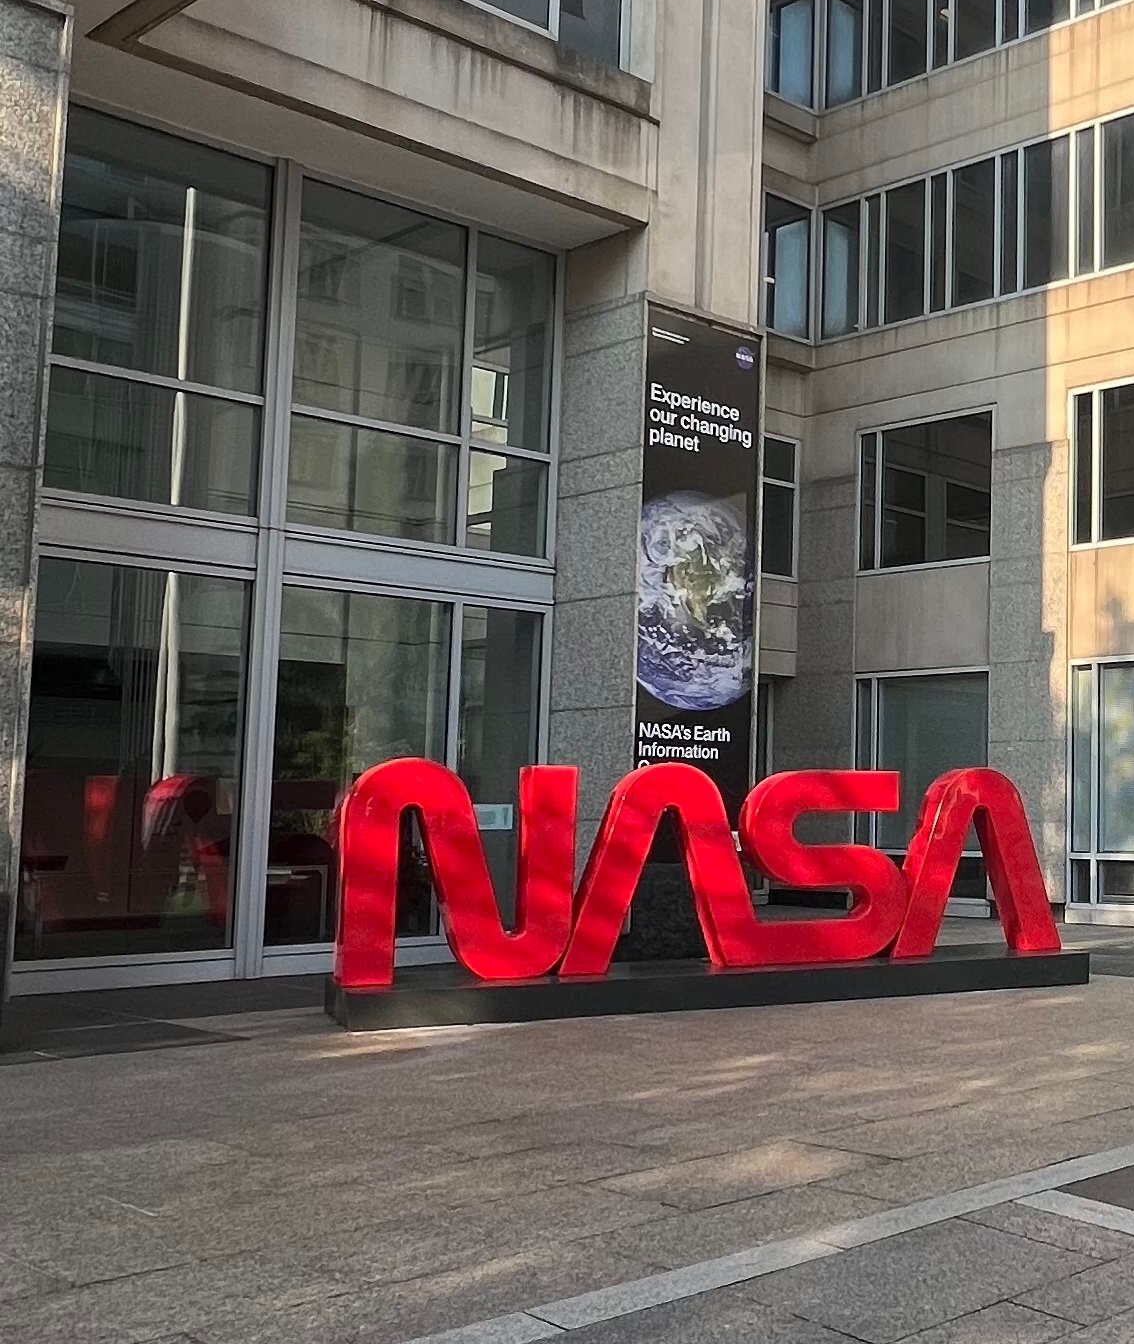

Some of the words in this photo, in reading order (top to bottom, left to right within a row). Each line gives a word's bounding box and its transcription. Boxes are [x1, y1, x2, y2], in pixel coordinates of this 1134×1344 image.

[650, 382, 740, 421] Experience
[649, 408, 678, 426] our
[680, 413, 752, 449] changing
[649, 427, 700, 452] planet
[639, 721, 691, 740] NASA's
[693, 725, 730, 742] Earth
[638, 740, 719, 759] Information
[332, 757, 1061, 988] NASA
